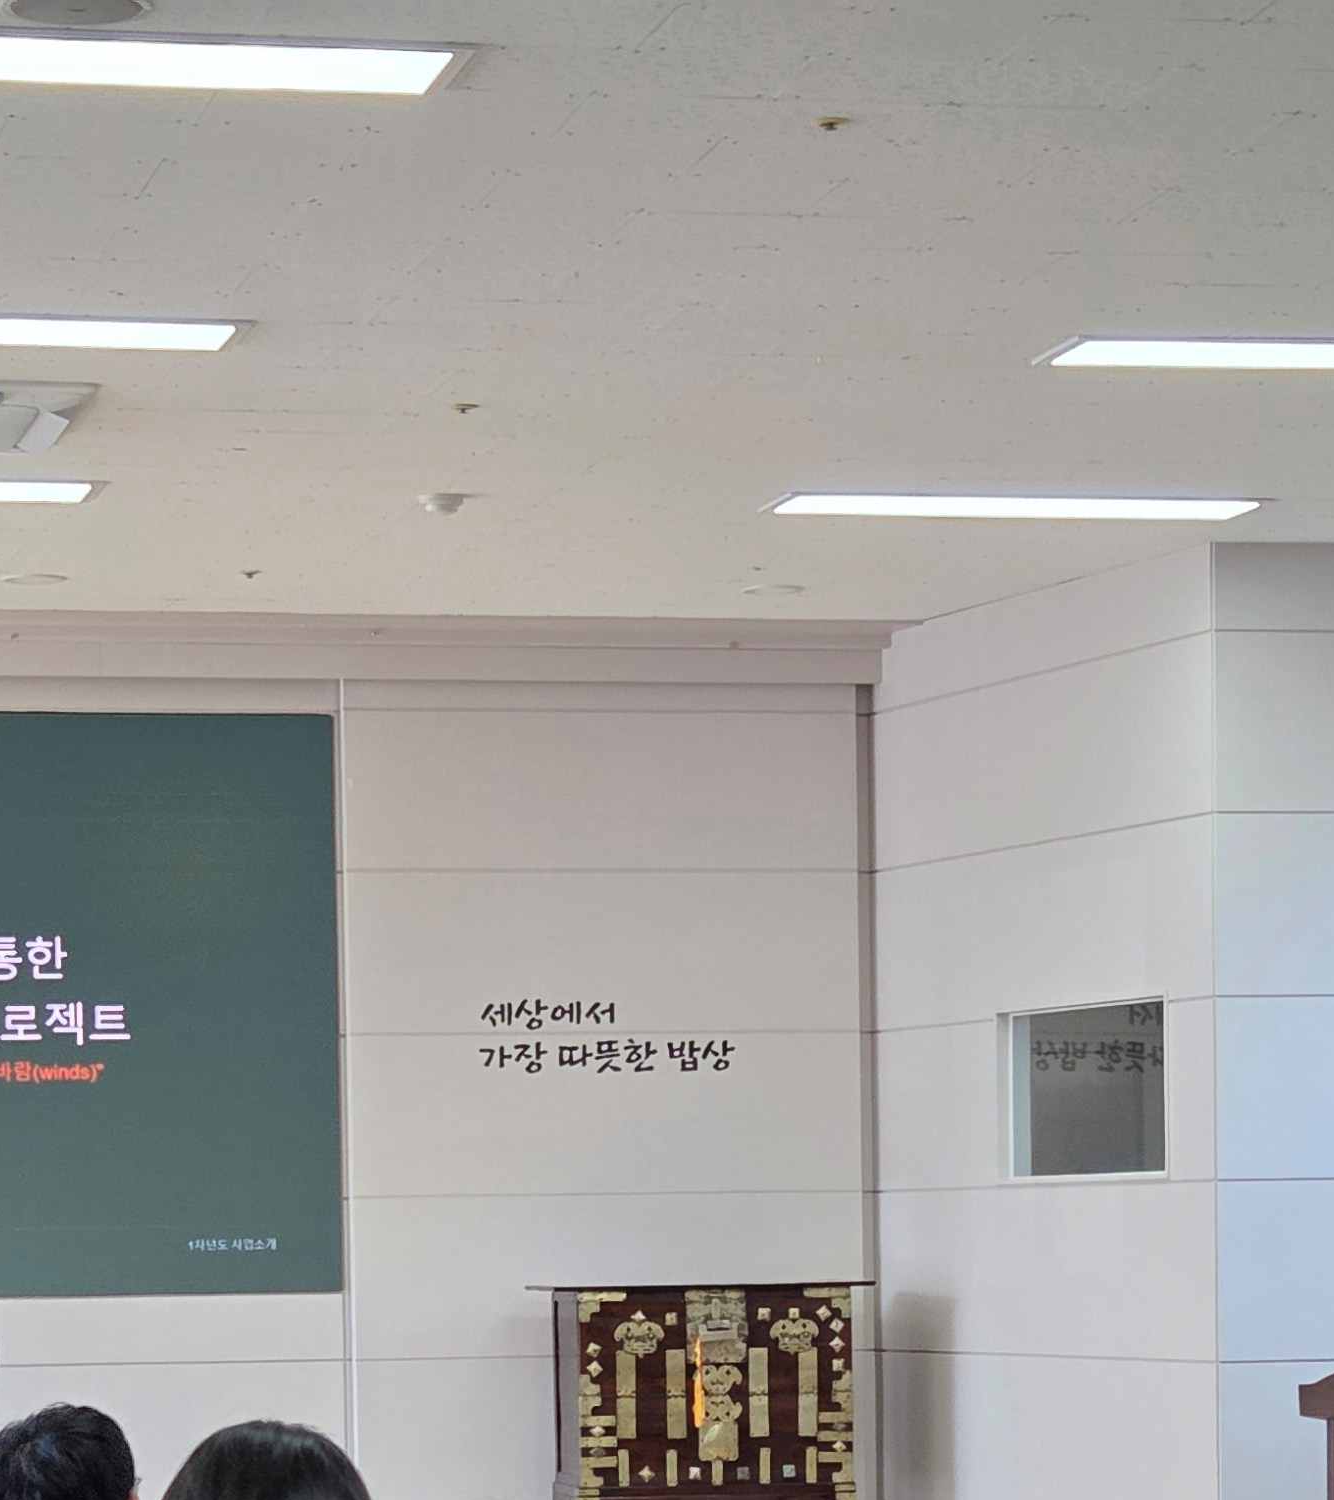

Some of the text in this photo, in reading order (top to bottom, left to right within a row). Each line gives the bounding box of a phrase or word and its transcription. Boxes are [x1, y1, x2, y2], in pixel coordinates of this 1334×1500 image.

[480, 998, 616, 1031] 세상에서
[478, 1038, 736, 1074] 가장 따뜻한 밥상
